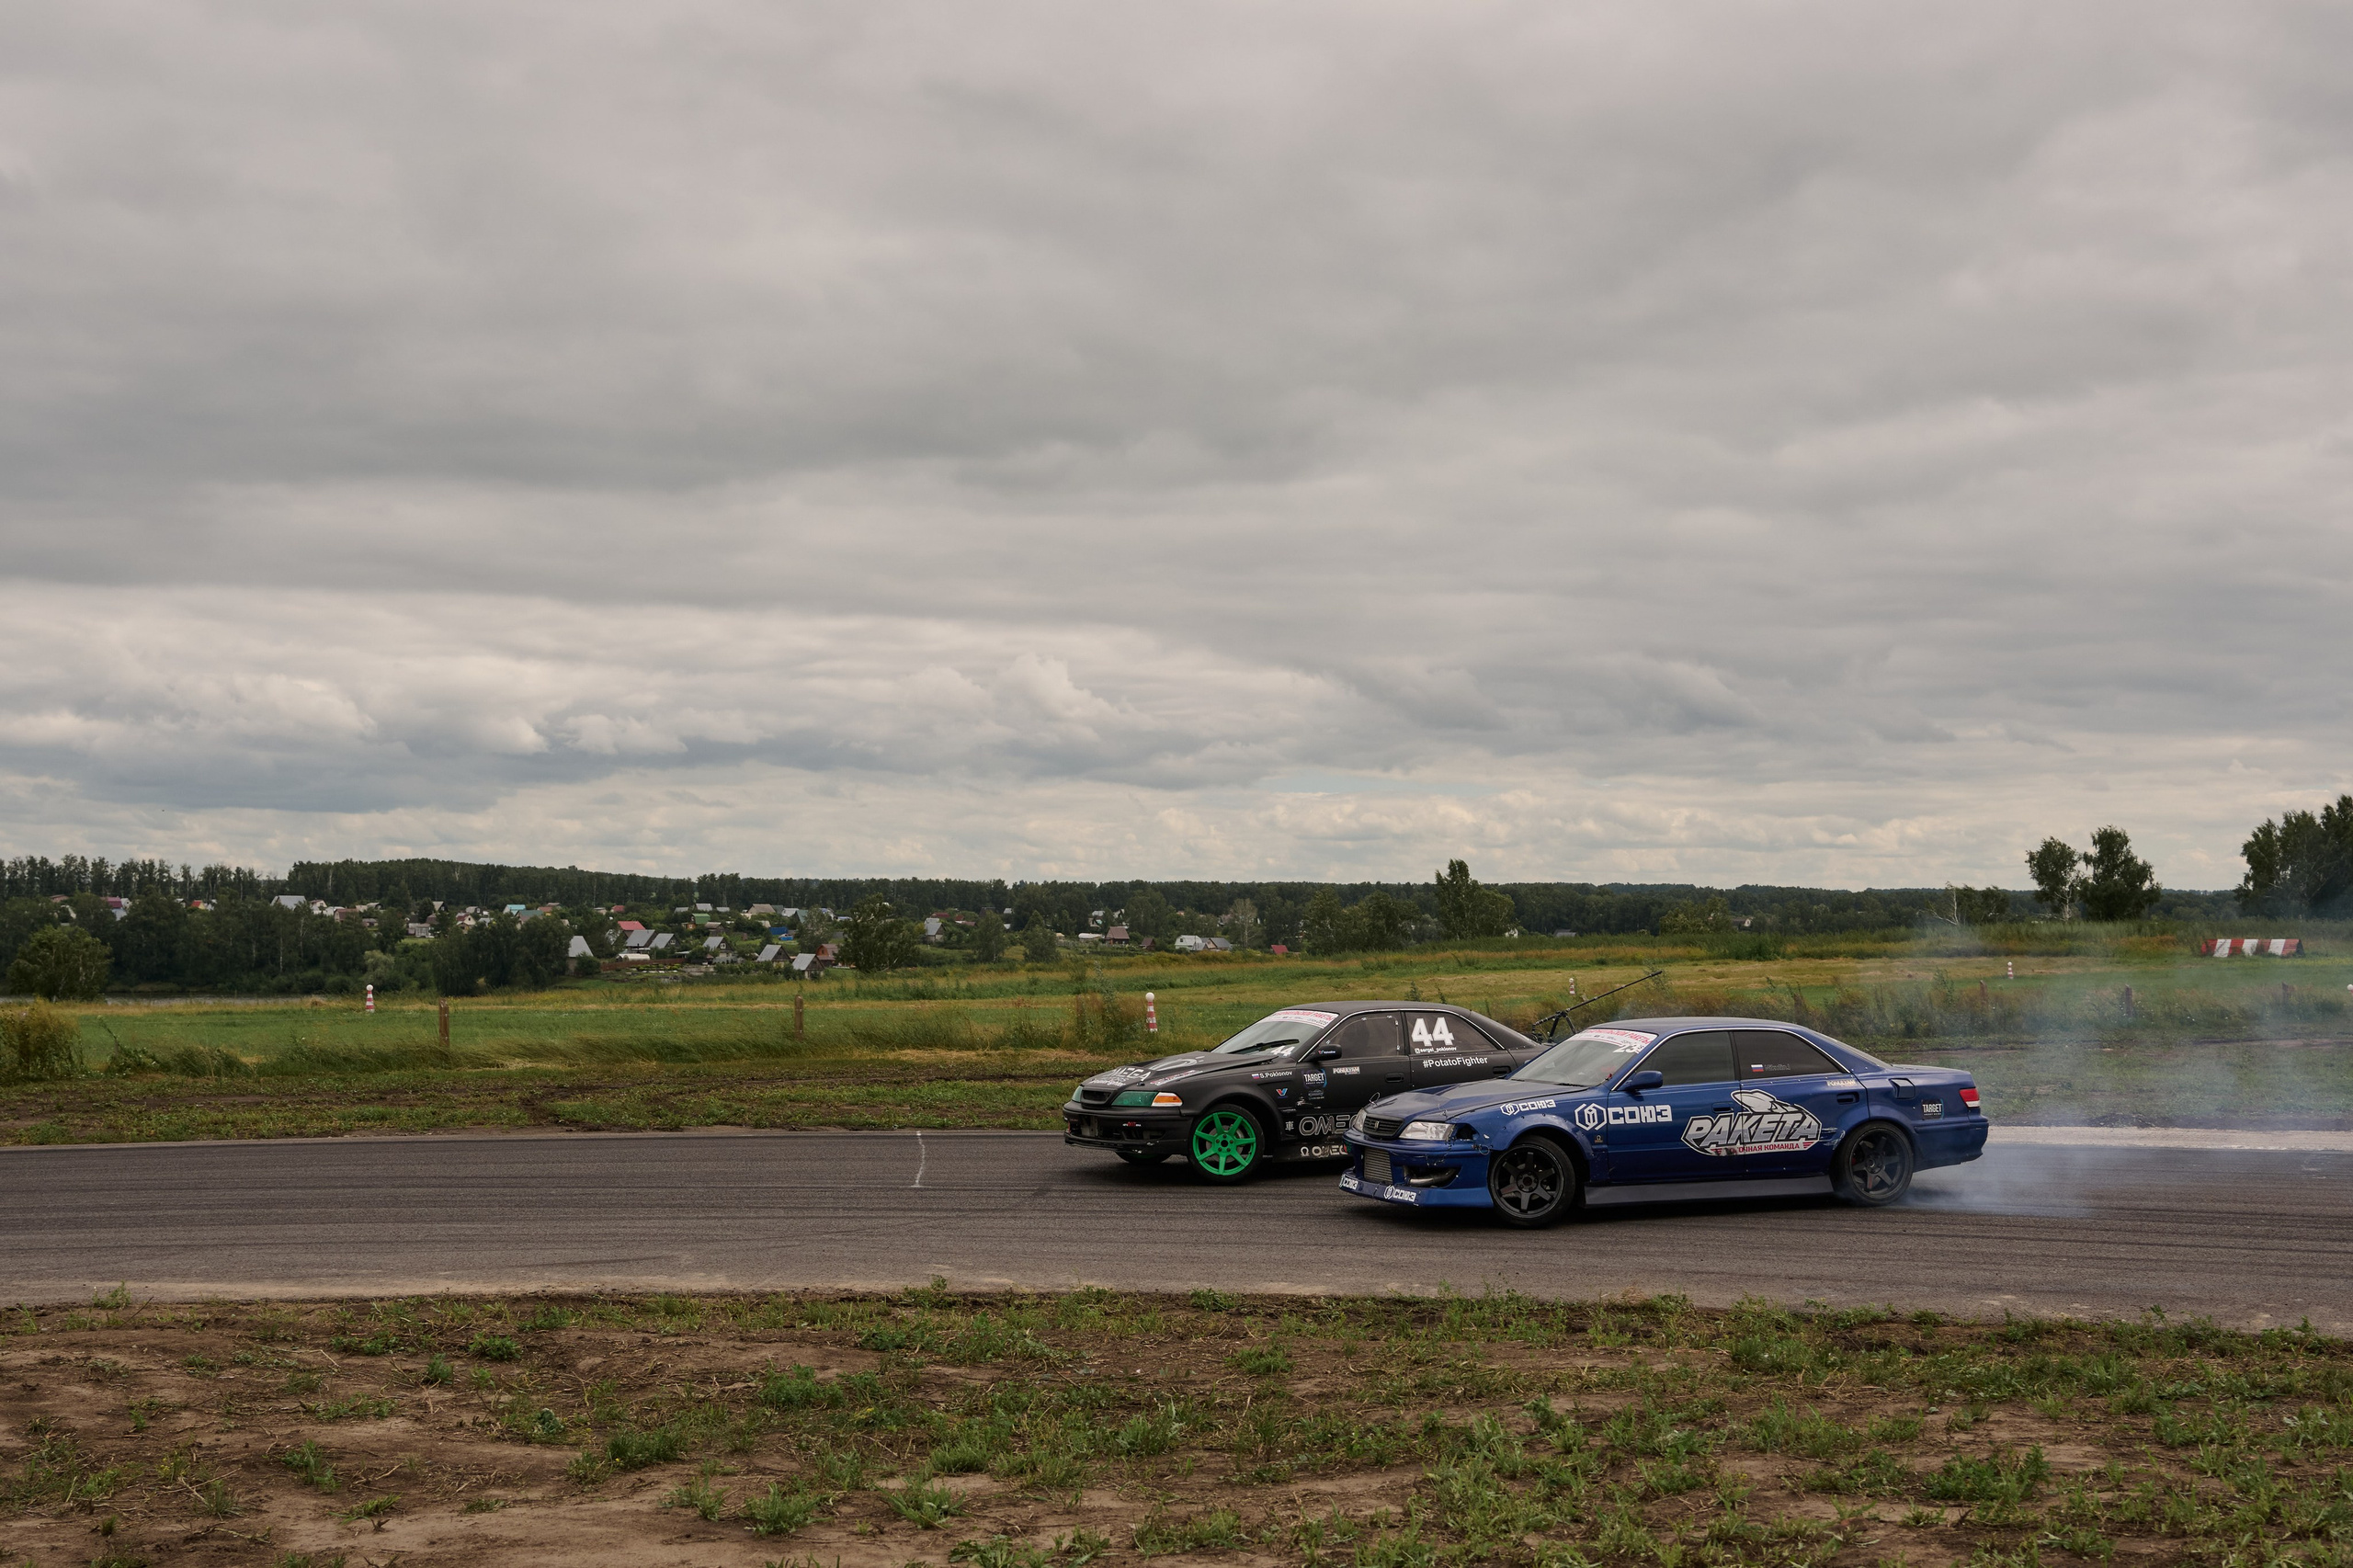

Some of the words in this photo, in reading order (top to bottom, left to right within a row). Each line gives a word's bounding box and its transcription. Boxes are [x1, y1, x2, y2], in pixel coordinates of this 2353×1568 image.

[1411, 1017, 1455, 1047] 44
[1270, 1045, 1295, 1056] 44
[1612, 1043, 1637, 1053] 23
[1422, 1056, 1488, 1068] #PotatoFighter
[1259, 1070, 1292, 1079] S.Poklonov
[1303, 1073, 1324, 1083] TARGET
[1518, 1098, 1556, 1111] СОЮЗ
[1922, 1103, 1942, 1113] TARGET
[1608, 1104, 1673, 1125] СОЮЗ
[1684, 1111, 1818, 1148] РАКЕТА
[1764, 1142, 1800, 1152] КОМАНДА
[1392, 1188, 1416, 1202] СОЮЗ
